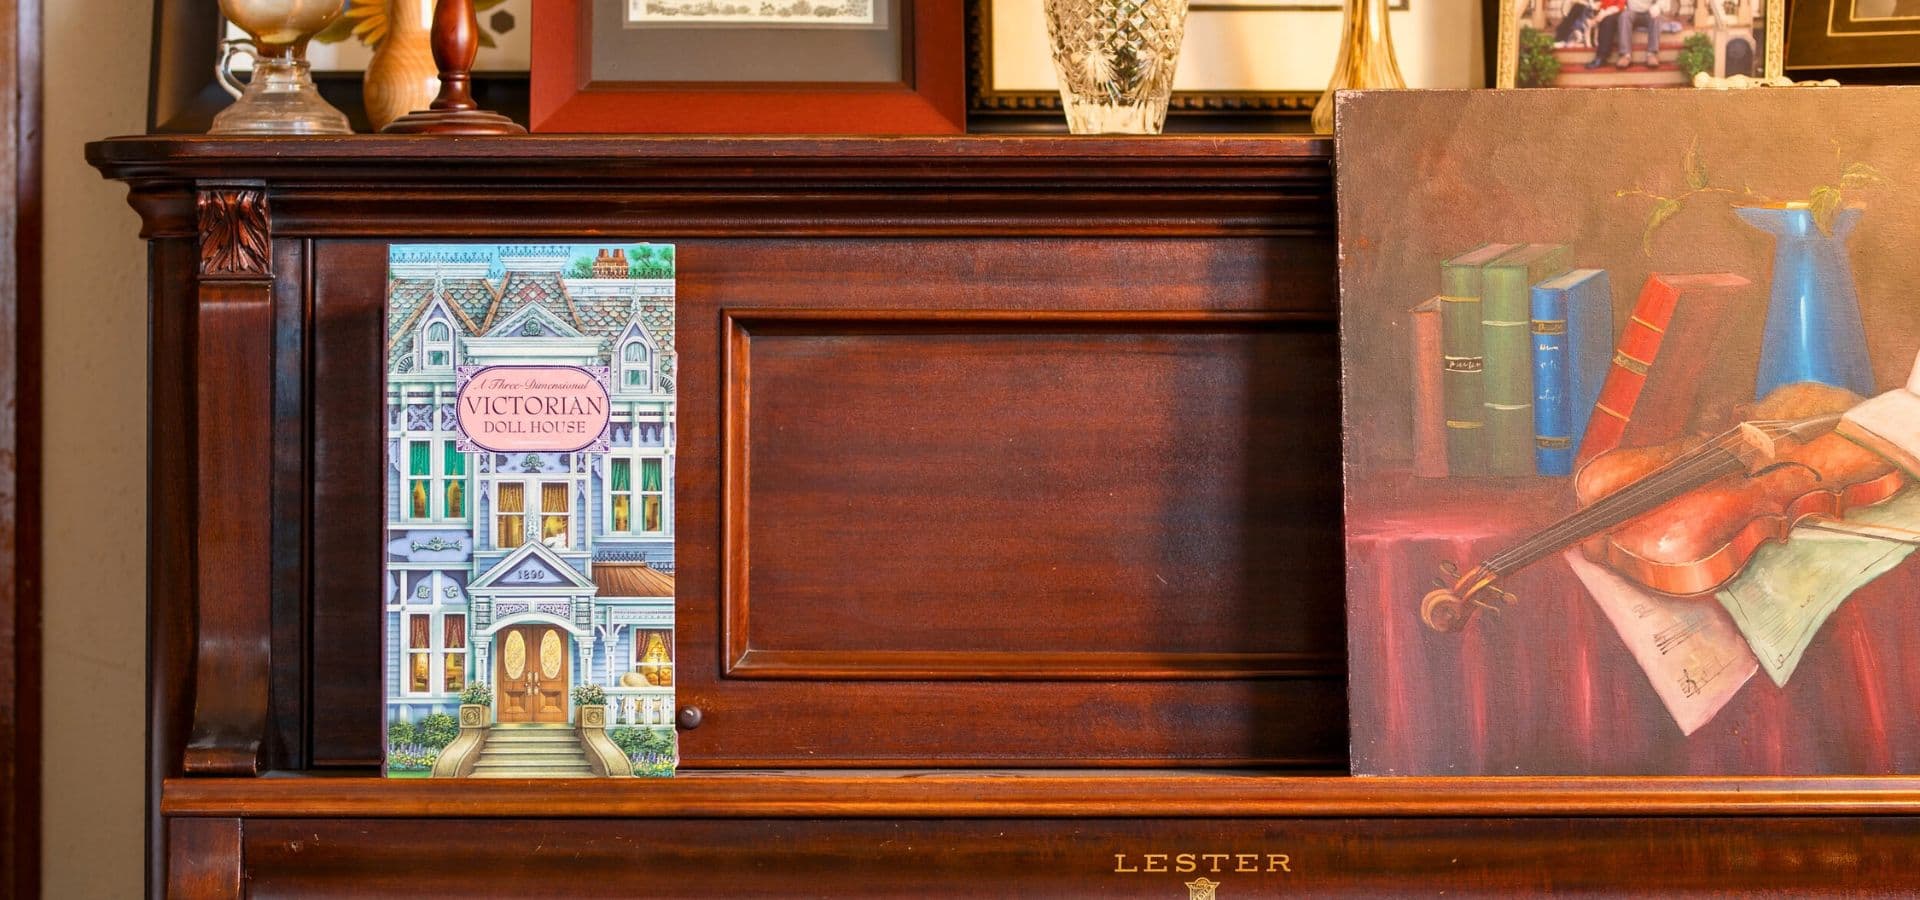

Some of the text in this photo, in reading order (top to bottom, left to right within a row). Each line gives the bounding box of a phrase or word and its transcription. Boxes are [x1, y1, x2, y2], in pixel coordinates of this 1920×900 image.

[474, 378, 591, 390] A Three-Dimensional
[465, 396, 603, 416] VICTORIAN
[484, 420, 586, 434] DOLL HOUSE
[517, 569, 545, 580] 1890
[1114, 853, 1291, 873] LESTER
